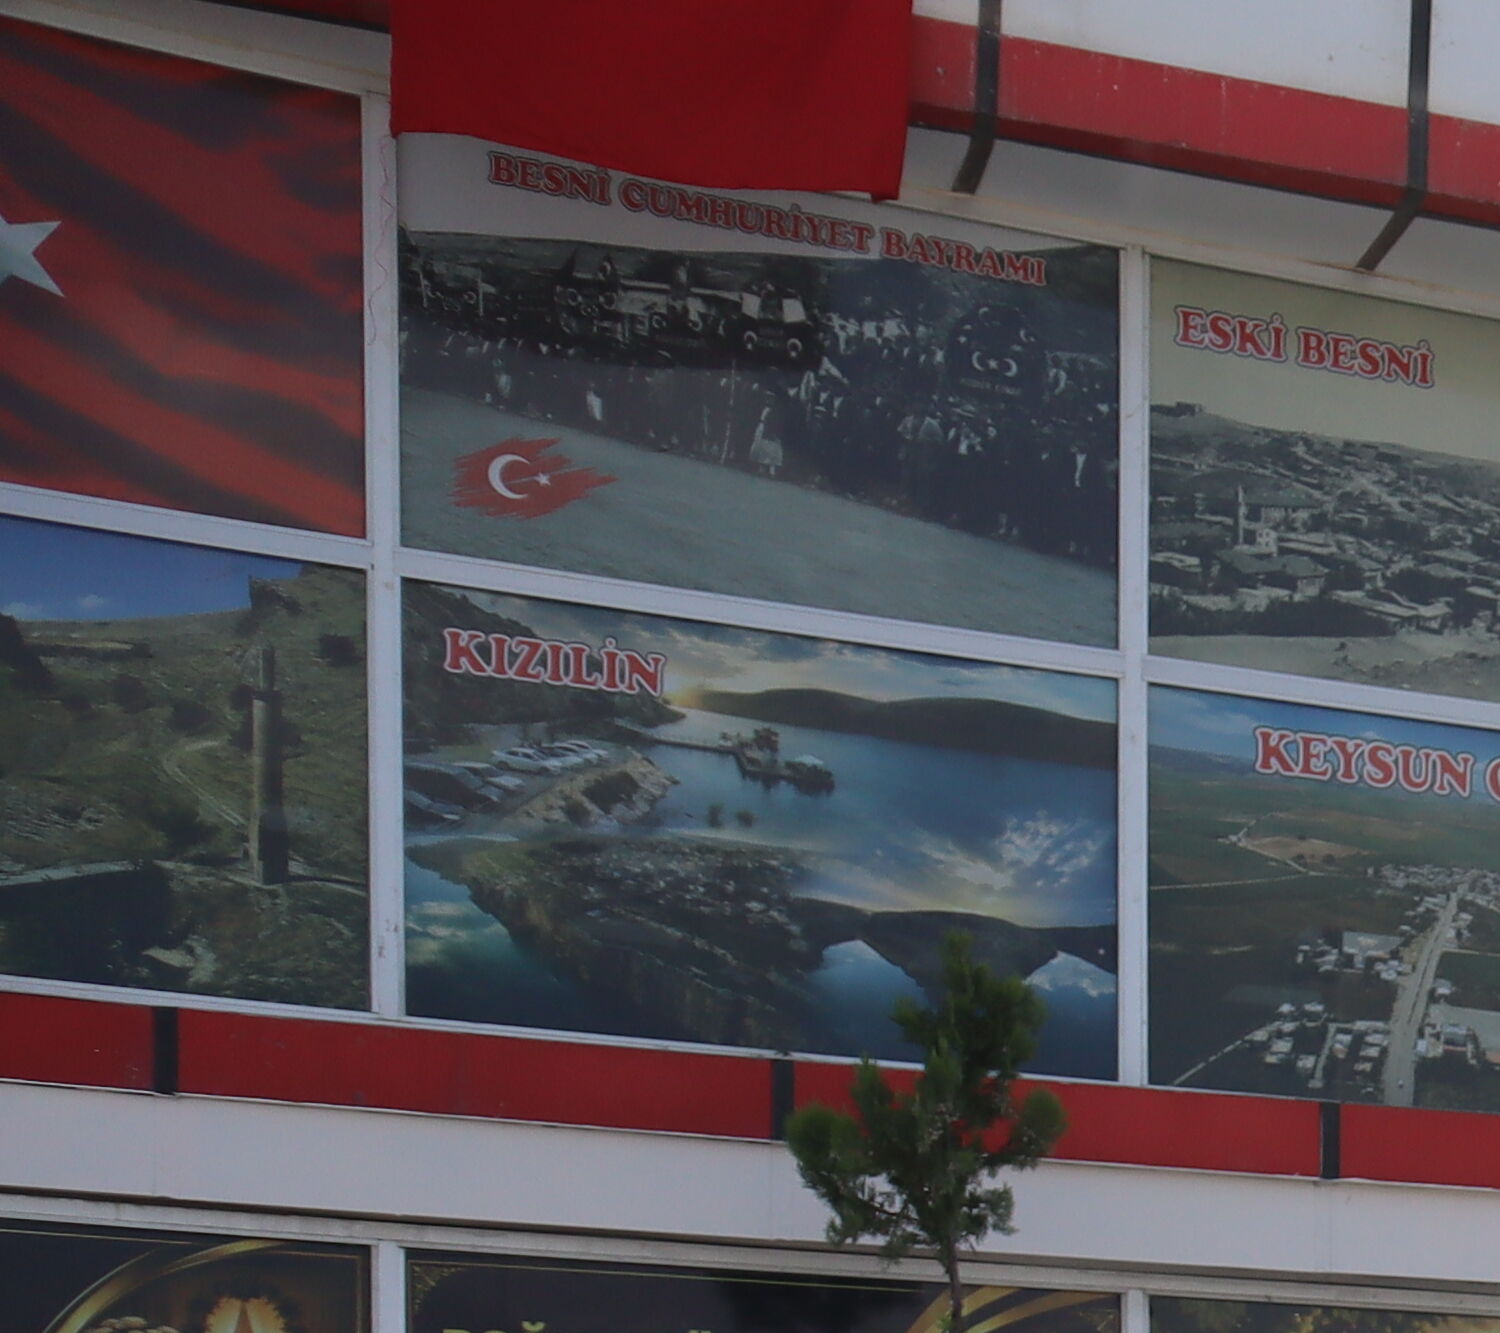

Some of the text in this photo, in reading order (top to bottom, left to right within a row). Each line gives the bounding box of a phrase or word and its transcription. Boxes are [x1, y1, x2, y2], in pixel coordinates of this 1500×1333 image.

[488, 150, 1047, 286] BESNİ CUMHURİYET BAYRAMI
[1174, 304, 1436, 389] ESKİ BESNİ
[444, 626, 667, 697] KIZILİN
[1252, 726, 1473, 798] KEYSUN
